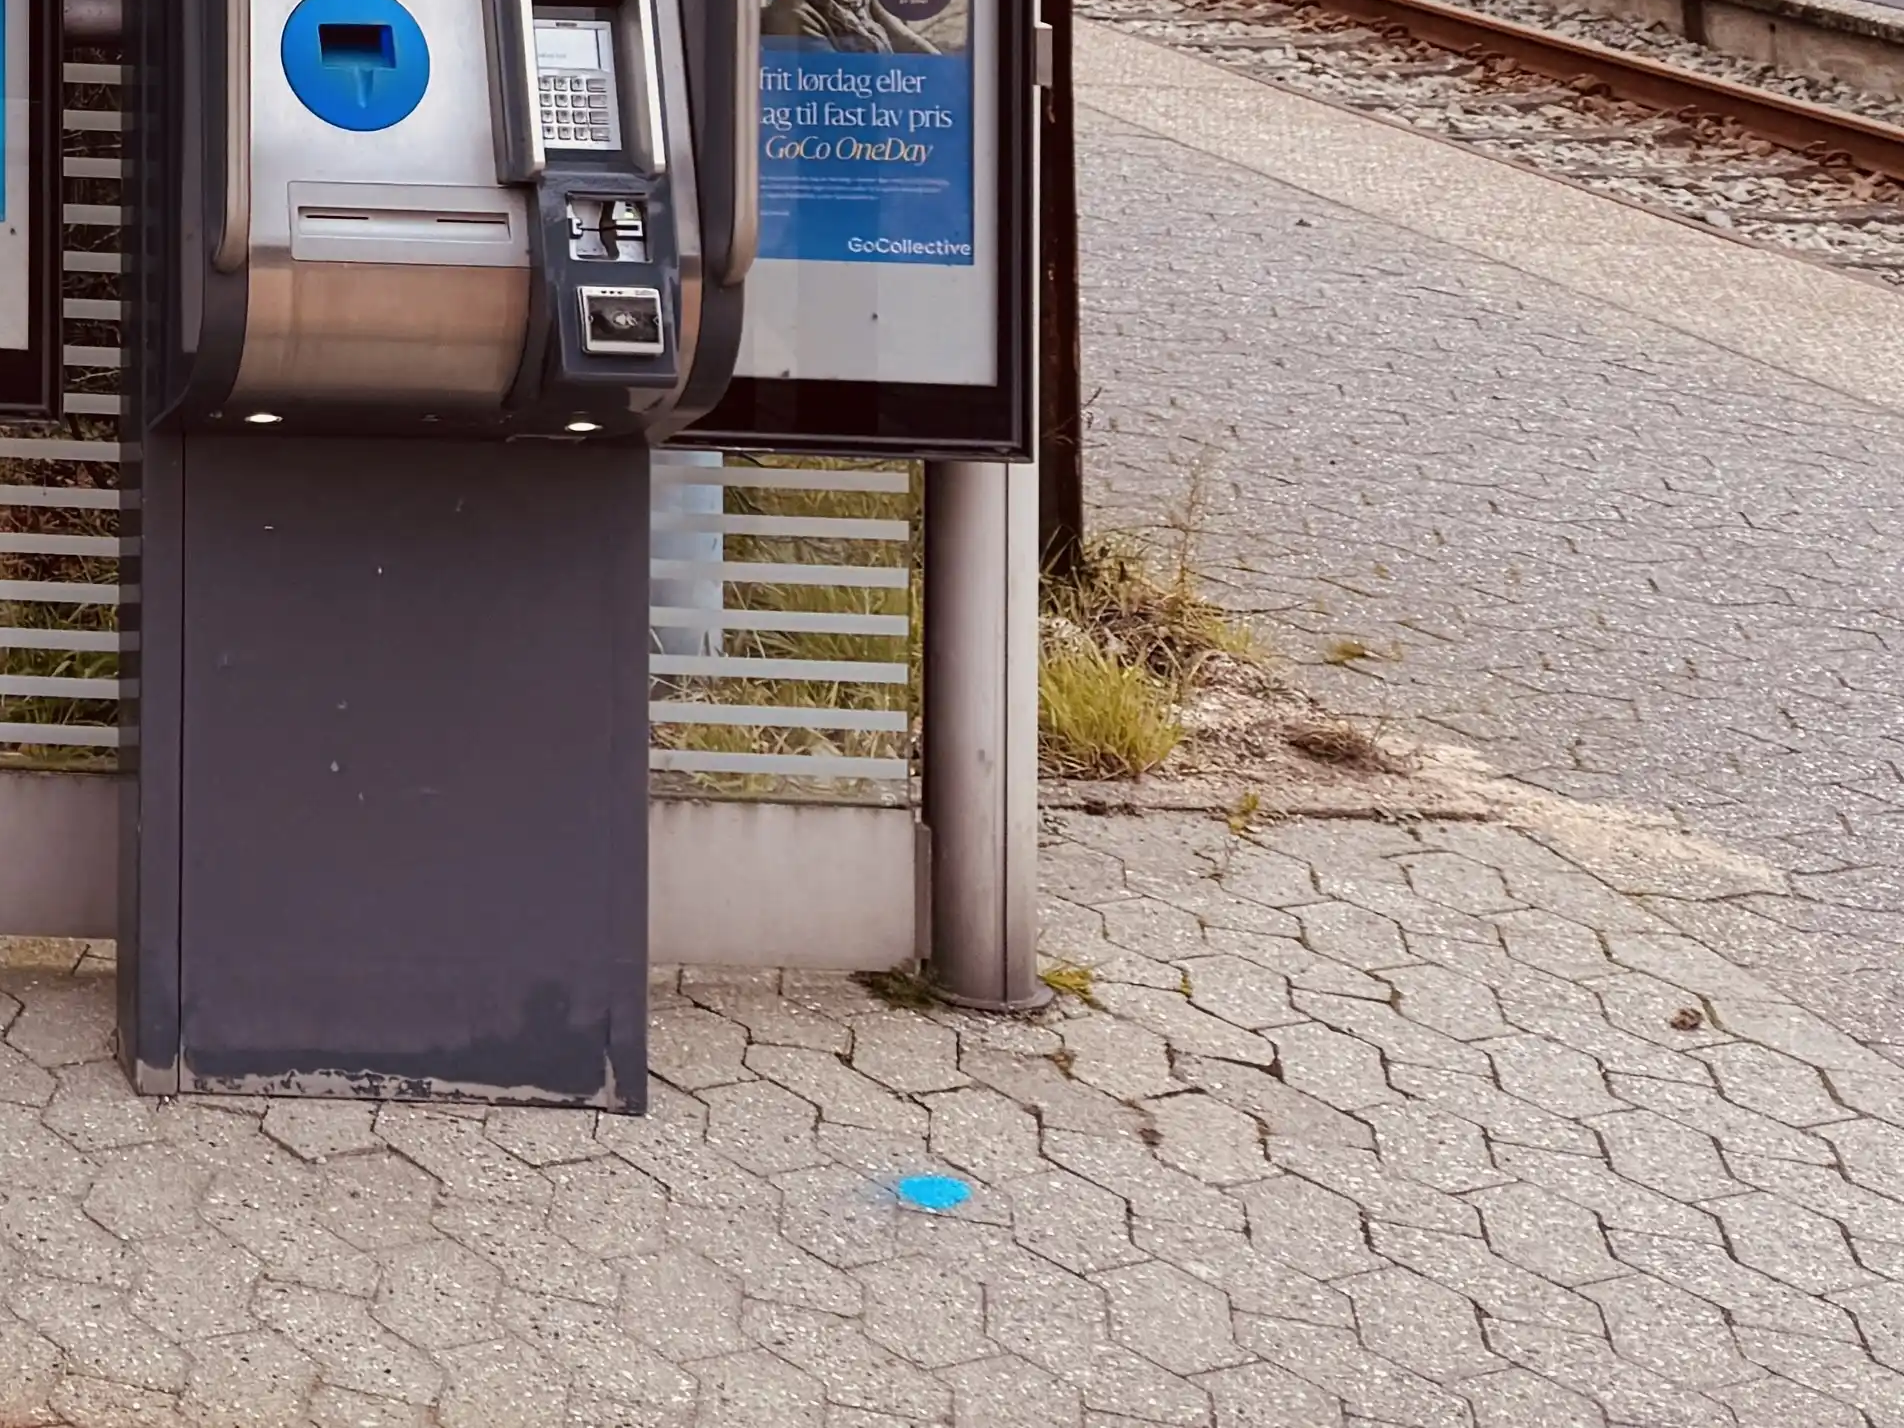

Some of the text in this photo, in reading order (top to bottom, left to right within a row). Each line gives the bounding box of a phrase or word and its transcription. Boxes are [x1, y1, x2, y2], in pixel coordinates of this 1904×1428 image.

[798, 68, 872, 98] lørdag
[876, 69, 927, 93] eller
[796, 103, 817, 126] til
[824, 102, 866, 126] fast
[872, 102, 902, 127] lav
[909, 105, 953, 132] pris
[766, 136, 933, 167] GoCo OneDay
[848, 237, 971, 256] GoCollective
